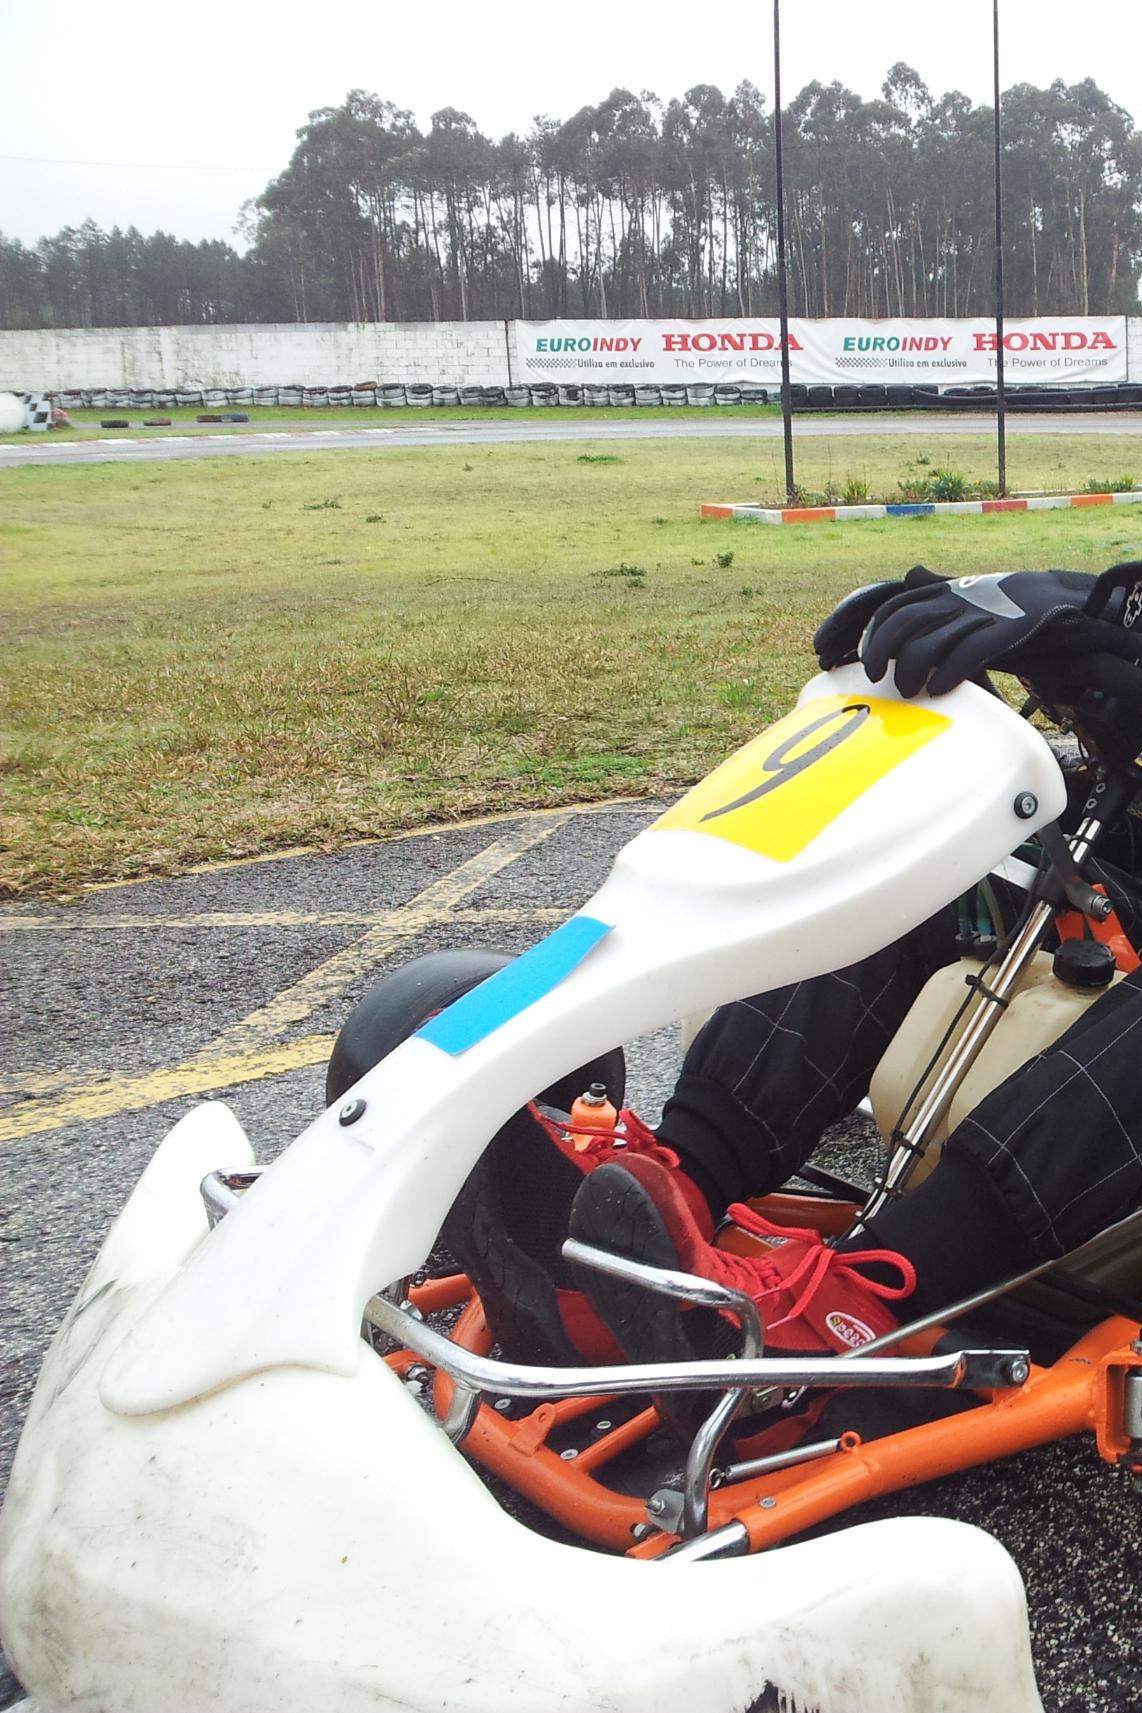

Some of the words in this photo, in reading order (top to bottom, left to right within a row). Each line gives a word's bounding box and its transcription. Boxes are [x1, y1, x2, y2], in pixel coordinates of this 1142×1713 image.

[536, 337, 642, 352] EUROINDY
[662, 333, 803, 351] HONDA
[843, 336, 953, 351] EUROINDY
[973, 332, 1117, 351] HONDA
[577, 359, 603, 368] Utiliza
[605, 360, 617, 368] em
[619, 359, 655, 368] exclusivo
[674, 358, 695, 368] The
[699, 358, 732, 368] Power
[736, 358, 746, 368] of
[888, 358, 914, 368] Utiliza
[917, 359, 929, 368] em
[931, 358, 967, 368] exclusivo
[1012, 357, 1046, 367] Power
[1050, 357, 1060, 367] of
[1064, 357, 1108, 367] Dreams
[699, 703, 871, 825] 9
